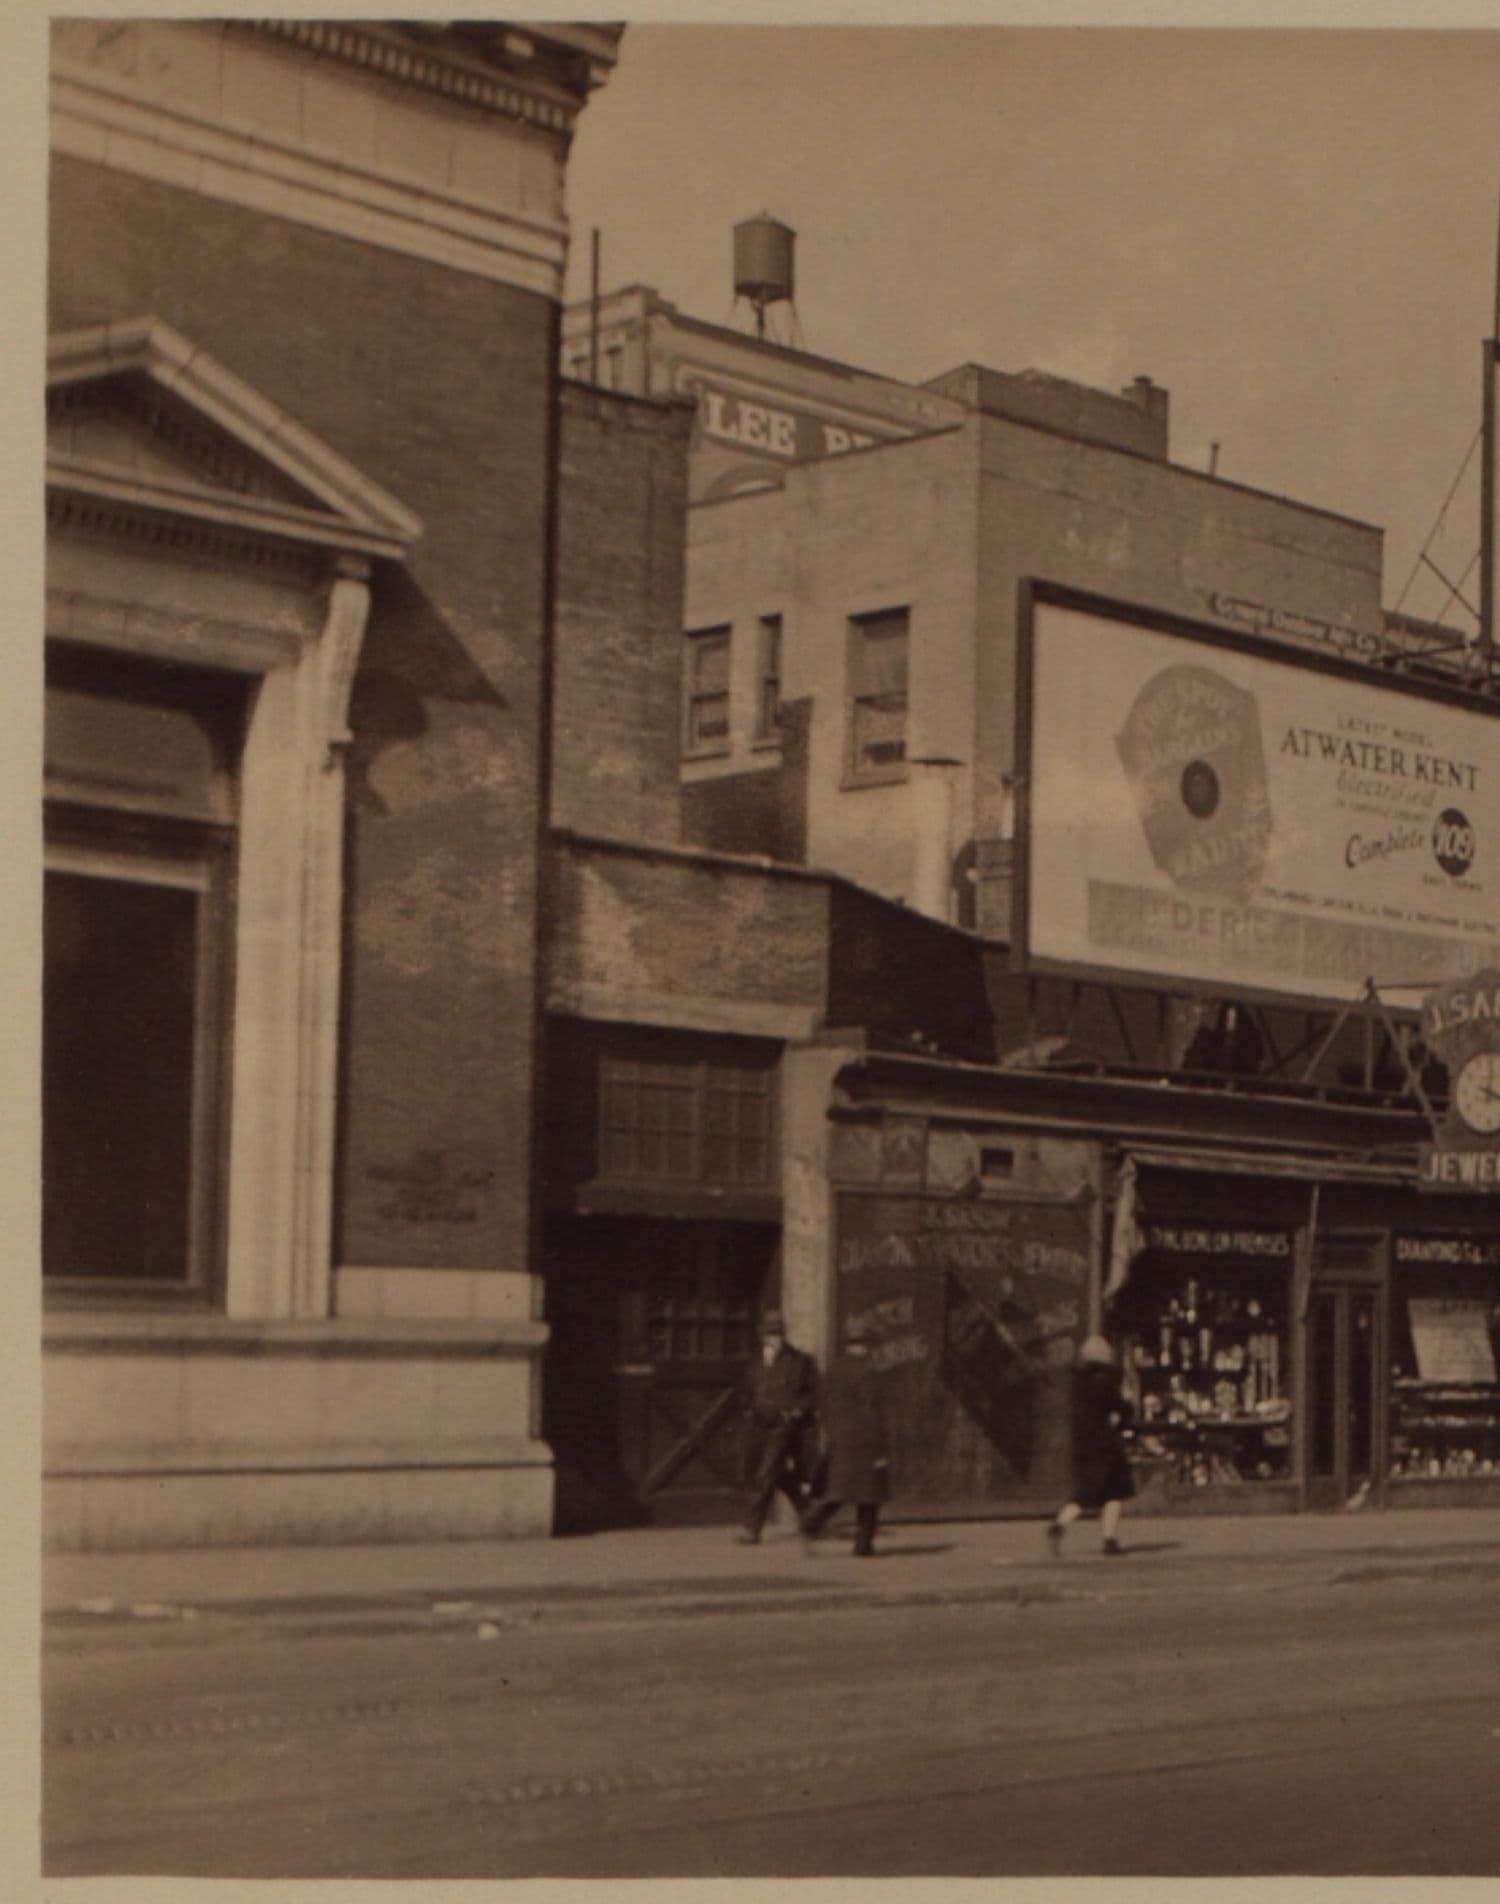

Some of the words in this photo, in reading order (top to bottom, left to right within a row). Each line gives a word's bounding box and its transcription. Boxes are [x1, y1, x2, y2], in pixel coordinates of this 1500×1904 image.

[705, 393, 797, 457] LEE
[1281, 726, 1407, 778] ATWATER
[1415, 752, 1481, 792] KENT
